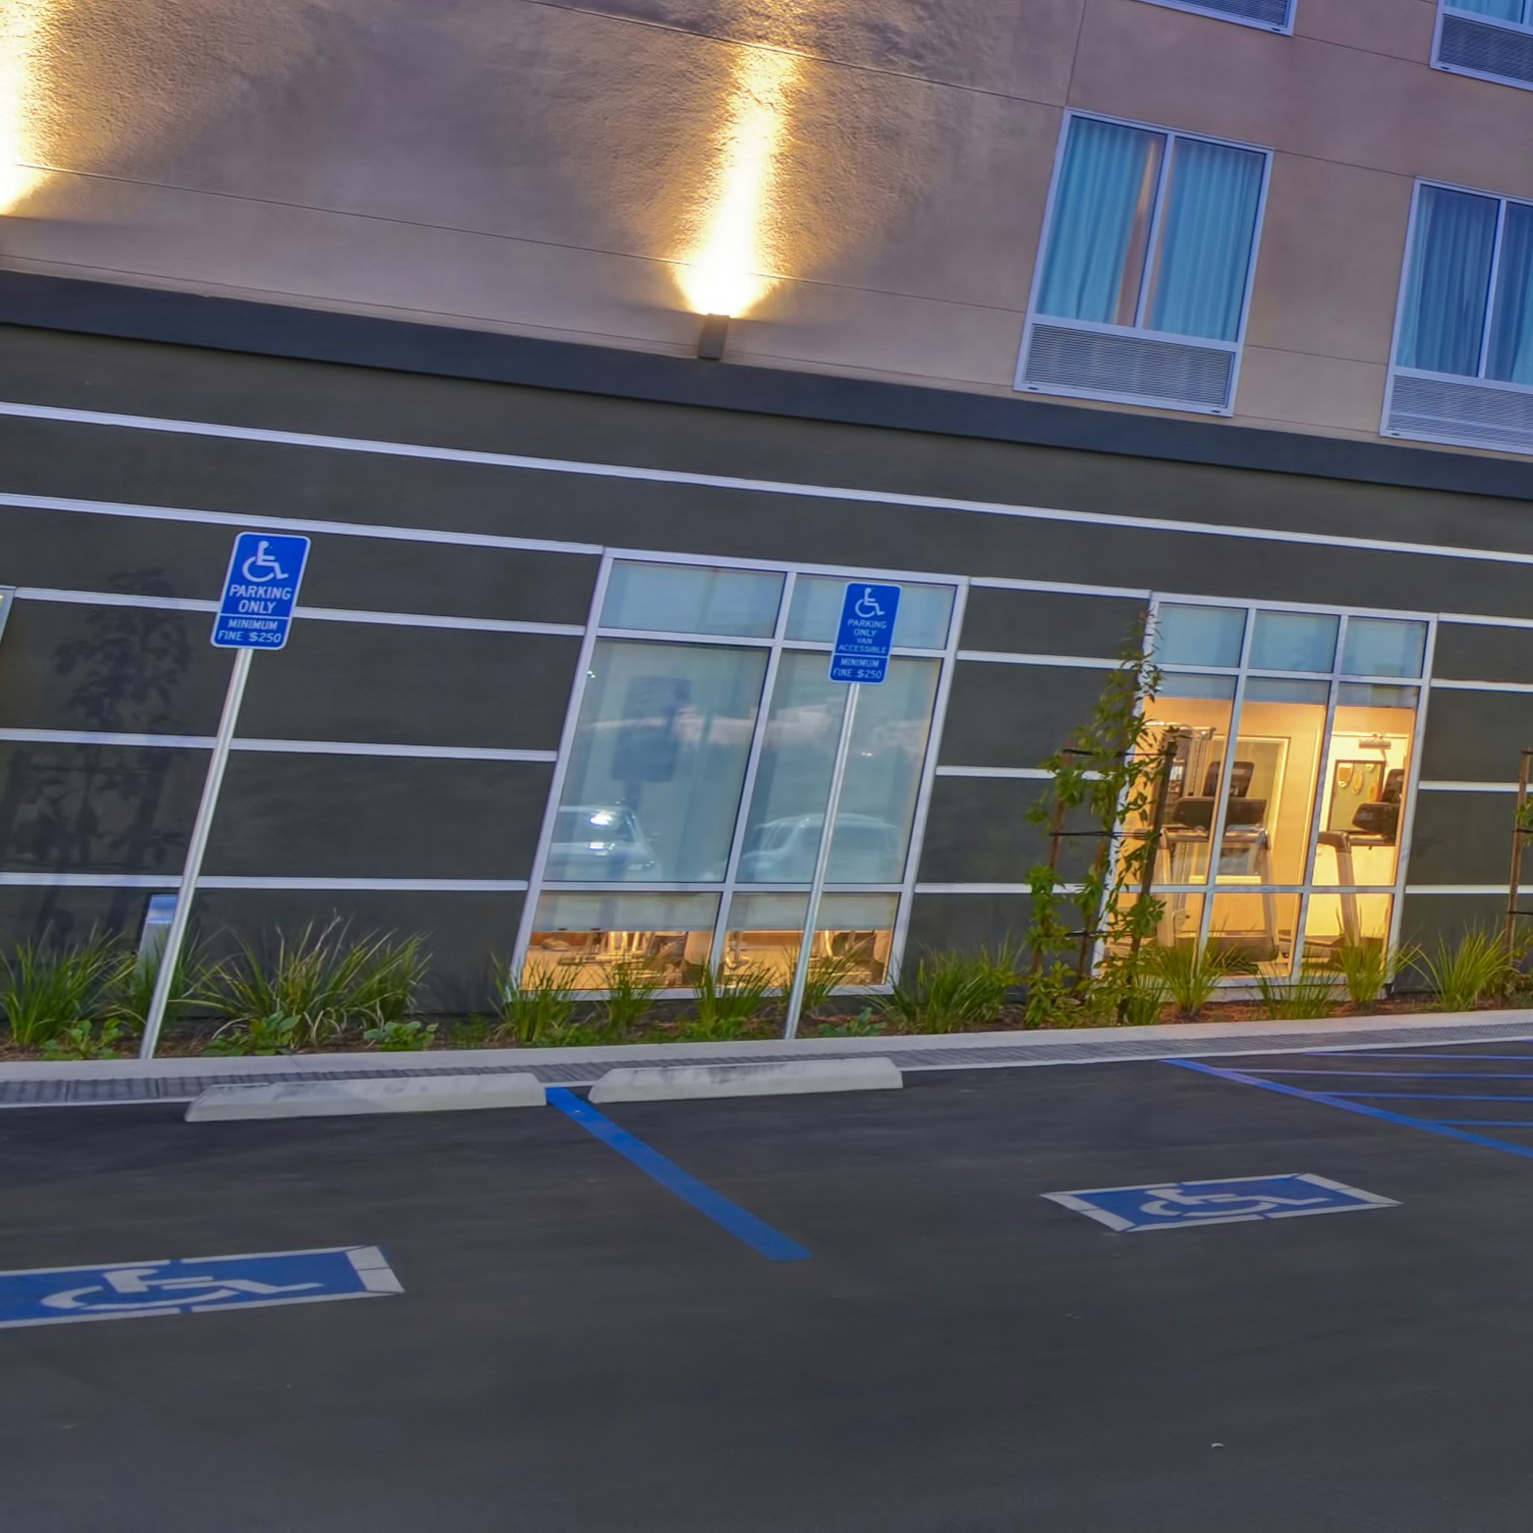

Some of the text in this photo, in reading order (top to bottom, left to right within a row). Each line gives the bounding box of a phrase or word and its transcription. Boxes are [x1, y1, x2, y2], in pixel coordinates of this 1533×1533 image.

[228, 584, 292, 600] PARKING
[238, 600, 277, 614] ONLY
[227, 618, 278, 630] MINIMUM
[847, 618, 887, 629] PARKING
[217, 630, 281, 643] FINE $250
[853, 628, 877, 637] ONLY
[838, 644, 887, 654] ACCESSIBLE
[840, 657, 880, 668] MINIMUM
[832, 668, 882, 679] FINE $250
